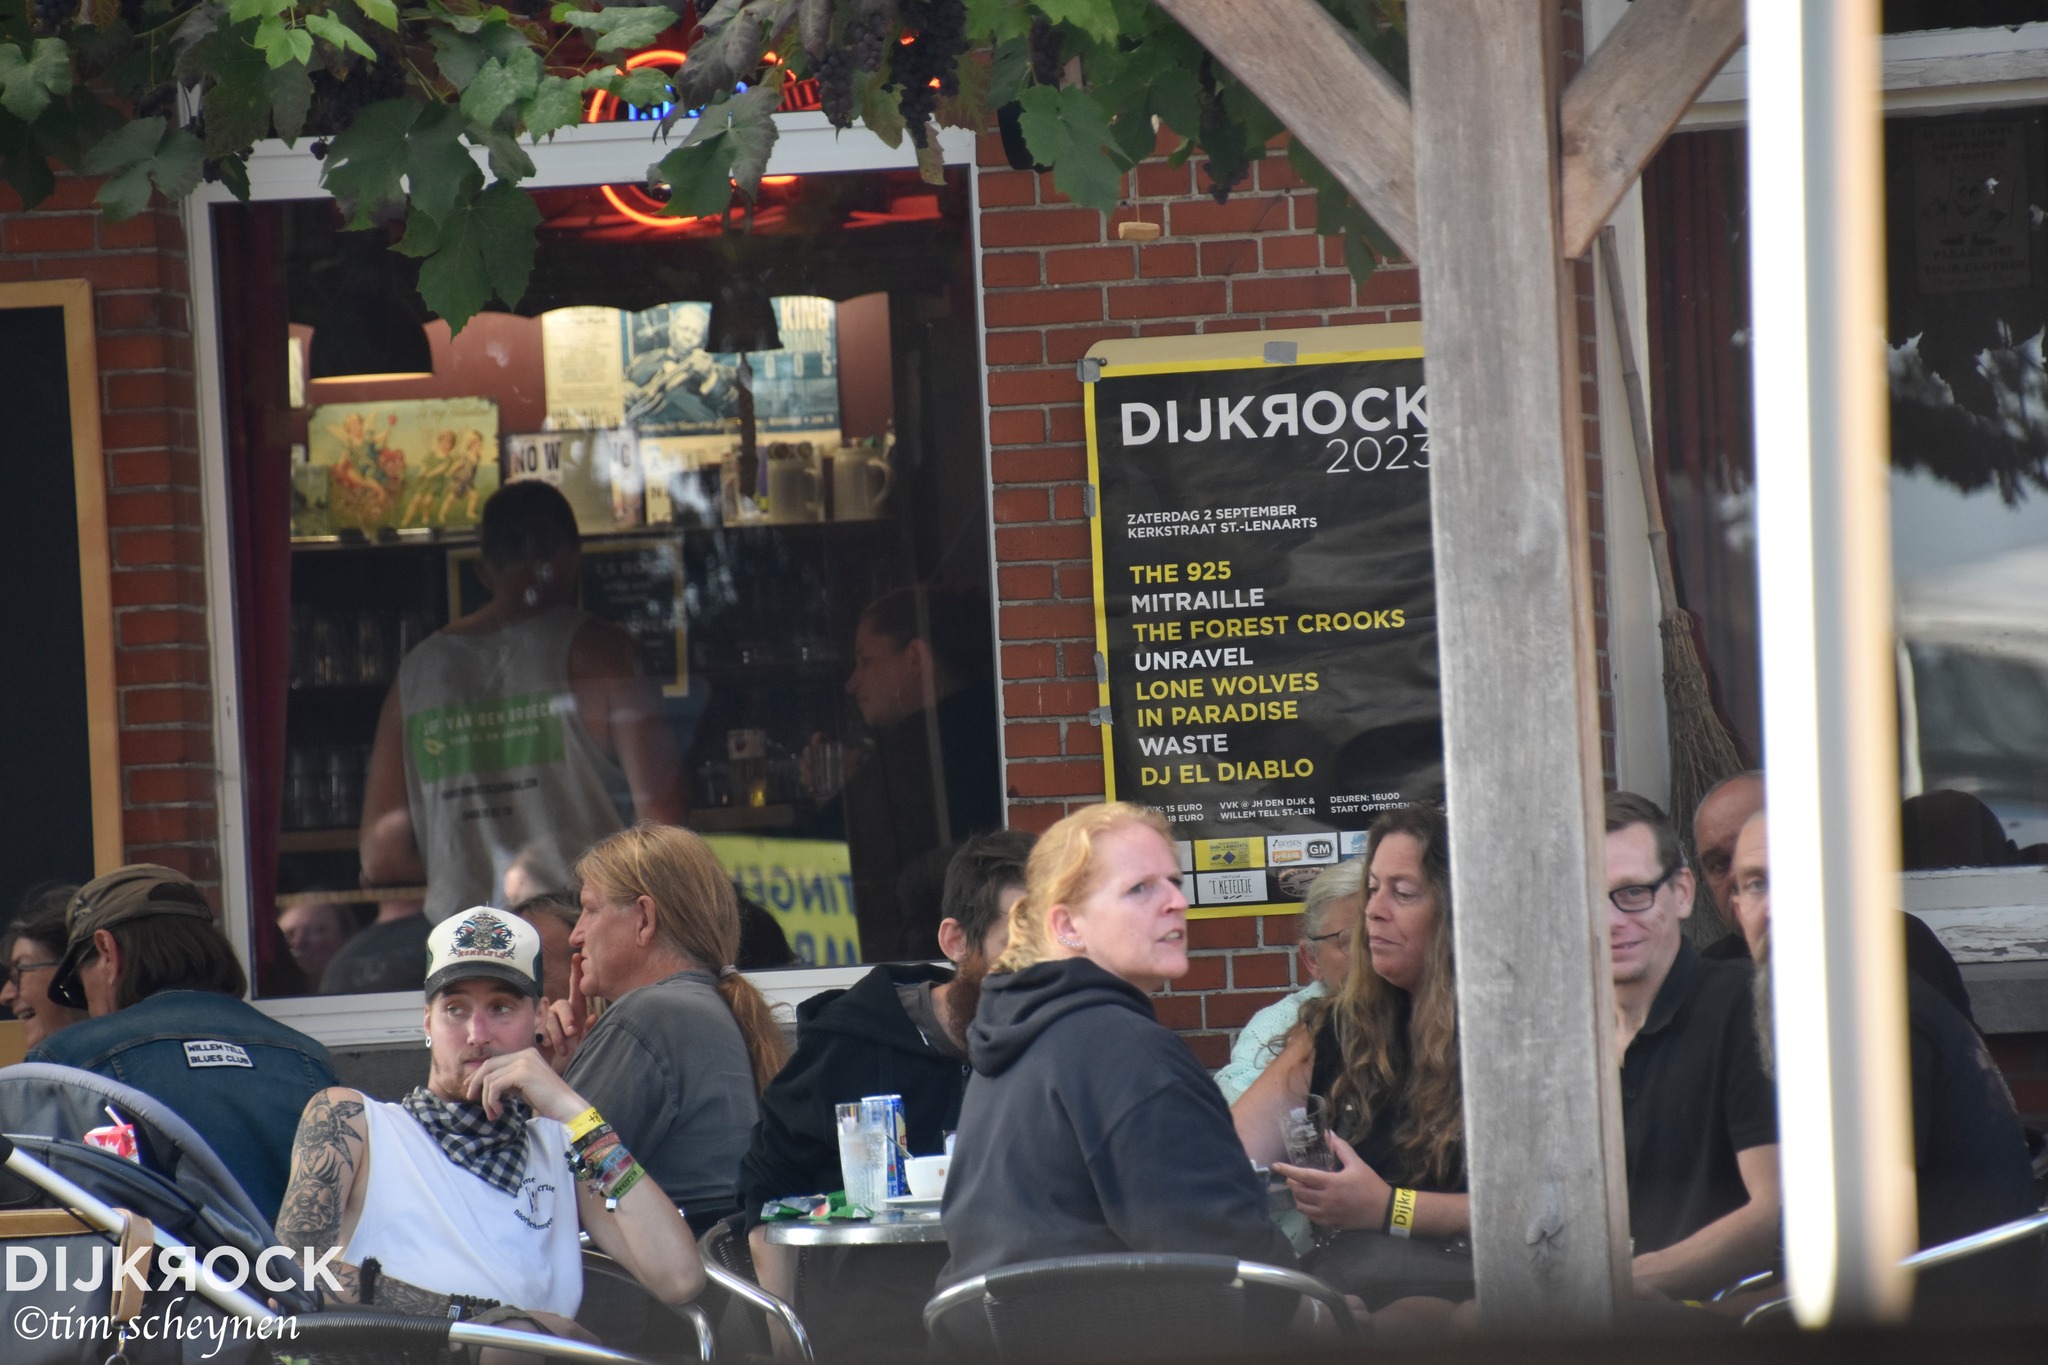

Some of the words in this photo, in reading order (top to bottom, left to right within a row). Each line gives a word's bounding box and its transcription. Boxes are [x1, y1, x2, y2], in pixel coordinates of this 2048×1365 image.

[1326, 433, 1431, 474] 2023
[1127, 509, 1200, 525] ZATERDAG
[1204, 509, 1212, 521] 2
[1216, 504, 1297, 520] SEPTEMBER
[1128, 523, 1216, 539] KERKSTRAAT
[1220, 517, 1318, 534] ST.-LENAARTS
[1130, 563, 1179, 585] THE
[1186, 560, 1232, 581] 925
[1131, 588, 1265, 614] MITRAILLE
[1133, 622, 1182, 642] THE
[1190, 616, 1289, 640] FOREST
[1297, 609, 1406, 633] CROOKS
[1134, 647, 1254, 671] UNRAVEL
[1136, 679, 1204, 701] LONE
[1212, 672, 1320, 697] WOLVES
[1137, 708, 1164, 727] IN
[1171, 700, 1299, 726] PARADISE
[1138, 733, 1229, 757] WASTE
[1141, 766, 1171, 786] DJ
[1180, 764, 1210, 784] EL
[1218, 758, 1315, 782] DIABLO
[1219, 801, 1239, 810] VVK
[1241, 800, 1250, 810] @
[1251, 800, 1263, 808] JH
[1265, 798, 1284, 807] DEN
[1286, 797, 1307, 806] DIJK
[1308, 797, 1315, 805] &
[1330, 794, 1370, 804] DEUREN:
[1371, 792, 1400, 801] 16U00
[1166, 804, 1176, 813] 15
[1177, 803, 1203, 812] EURO
[1220, 810, 1256, 820] WILLEM
[1258, 809, 1280, 818] TELL
[1330, 805, 1359, 814] START
[1361, 802, 1415, 812] OPTREDEN
[1167, 815, 1177, 823] 18
[1178, 813, 1204, 822] EURO
[1277, 839, 1302, 848] GEYSEN
[1309, 843, 1330, 855] GM
[1219, 878, 1253, 895] KETELTJE
[187, 1043, 224, 1052] WILLEM
[224, 1045, 245, 1055] TELL
[190, 1054, 224, 1064] BLUES
[225, 1055, 250, 1065] CLUB
[537, 1184, 556, 1193] crue
